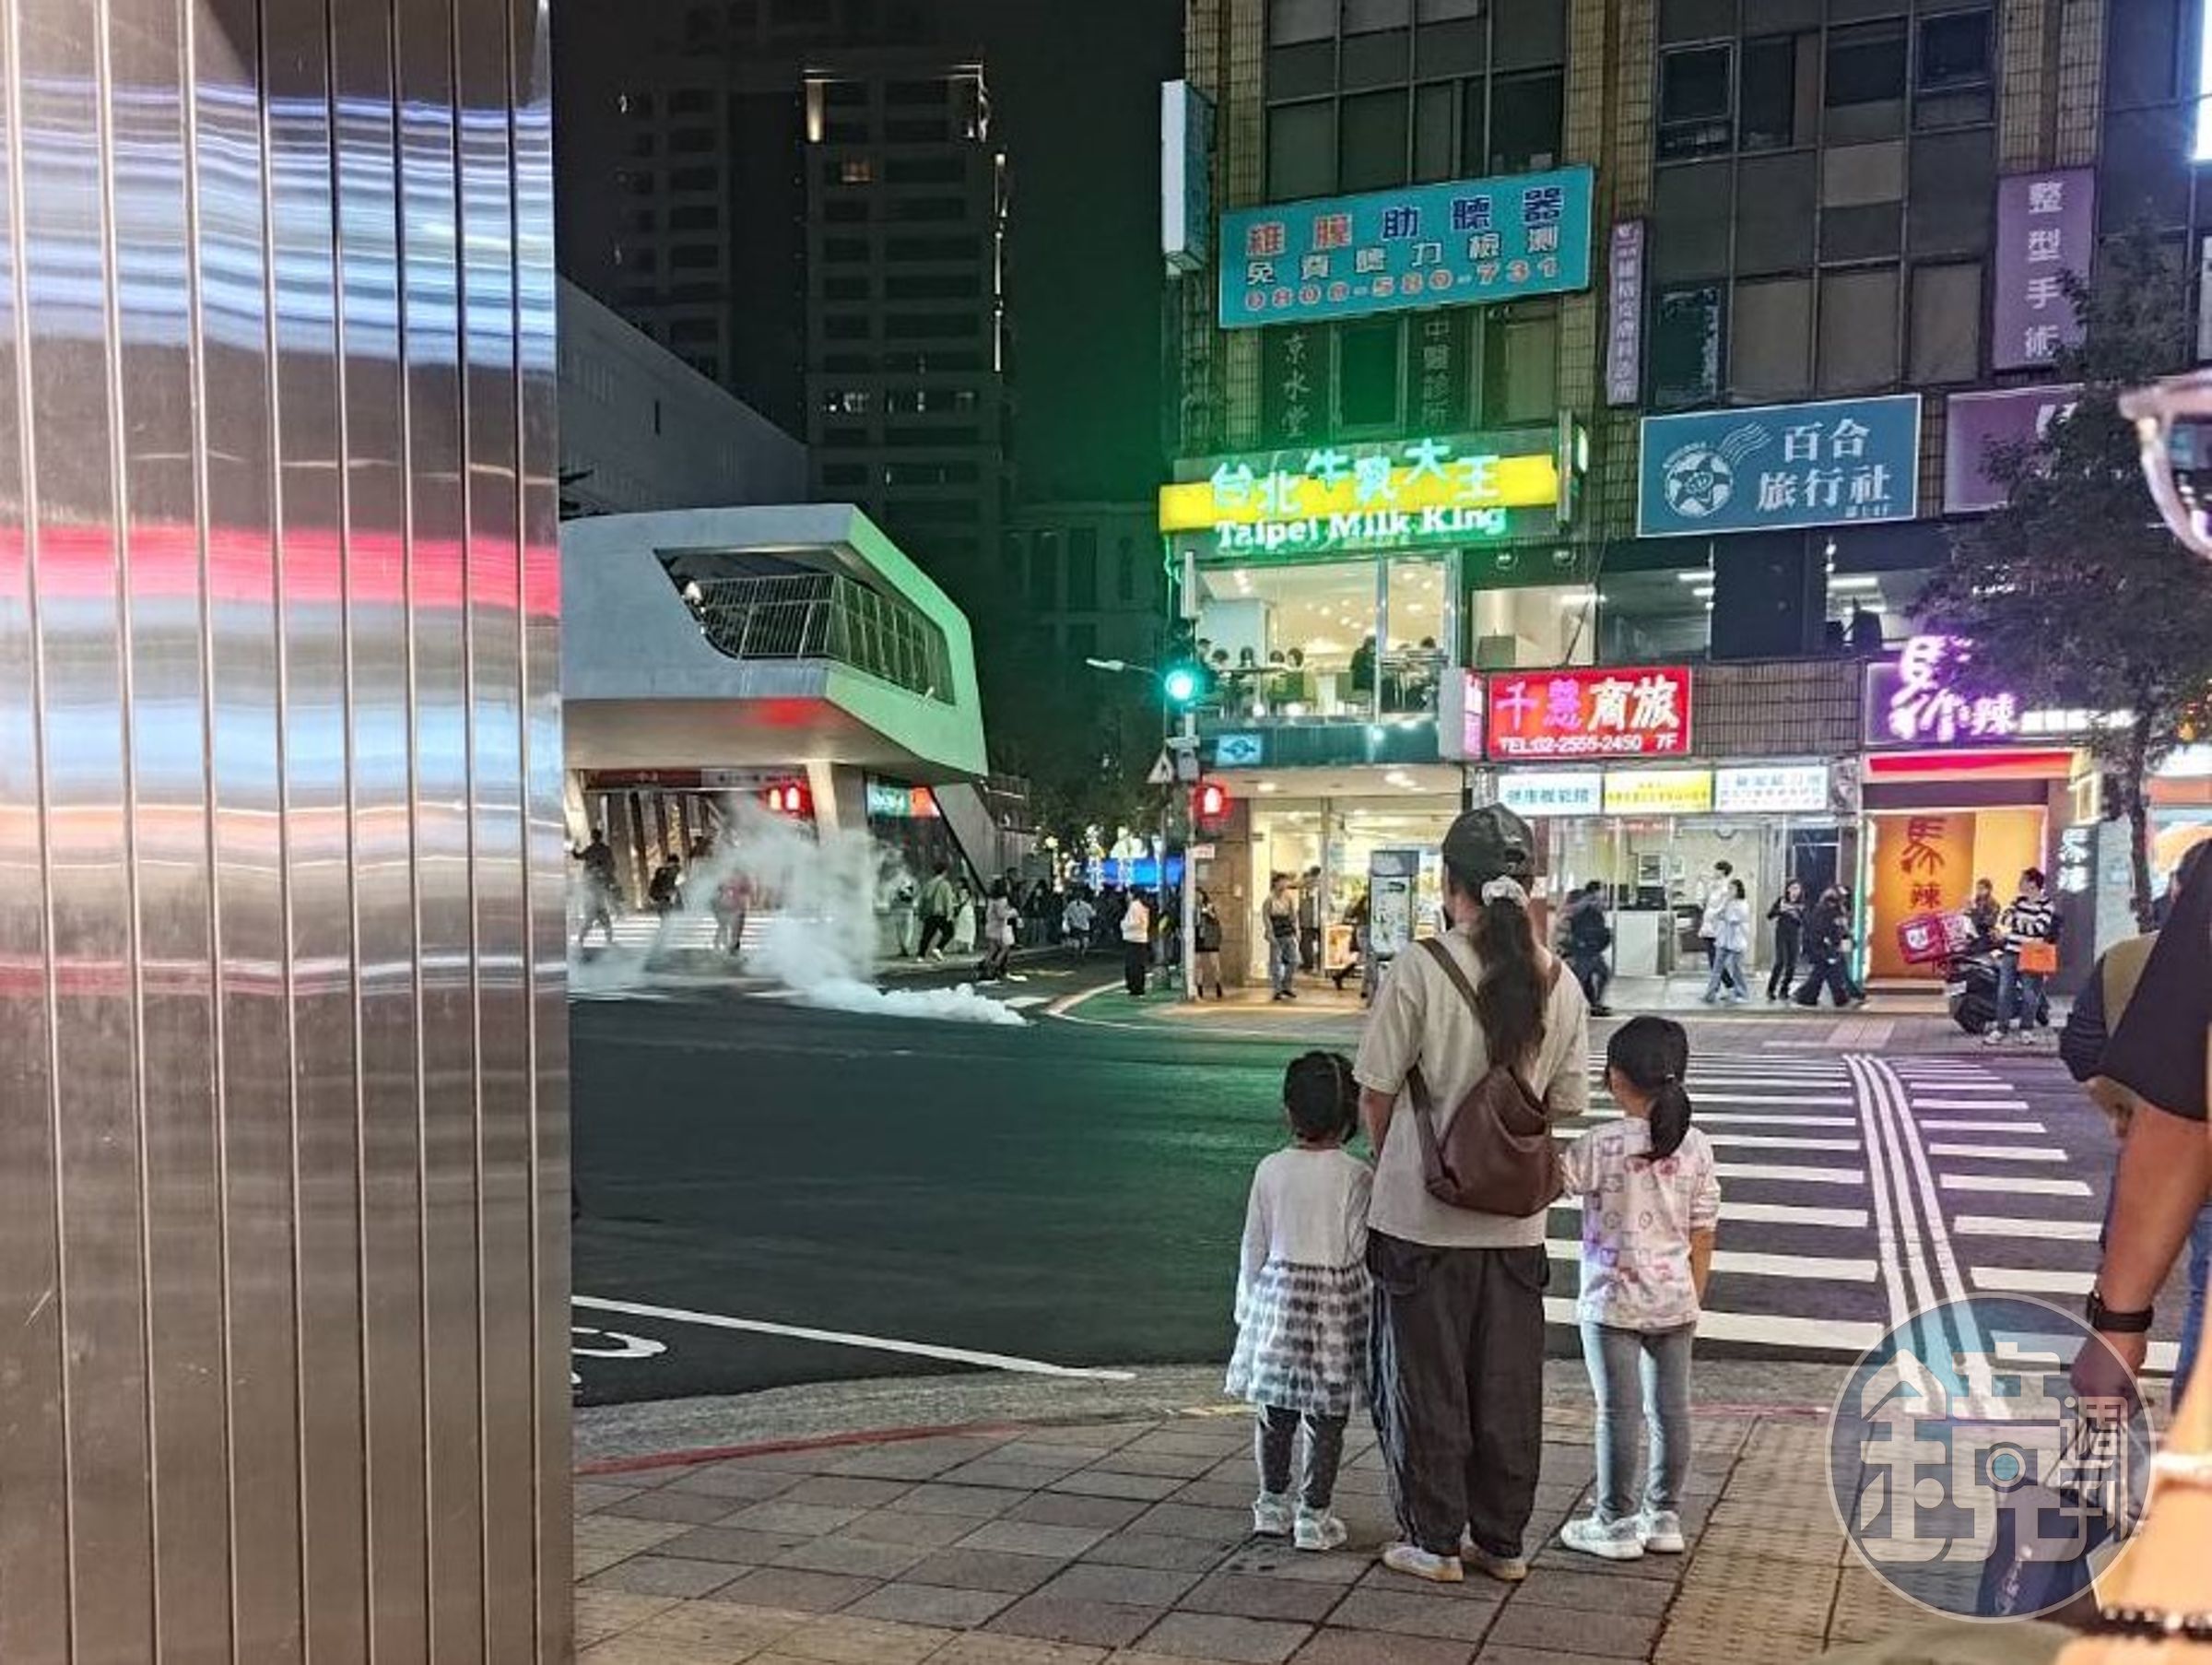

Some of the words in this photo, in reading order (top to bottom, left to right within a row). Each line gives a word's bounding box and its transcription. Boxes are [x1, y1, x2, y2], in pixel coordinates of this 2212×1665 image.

[1247, 226, 1559, 286] 免費聽力檢測
[2025, 182, 2064, 360] 整型手術
[1422, 316, 1452, 428] 中醫診所
[1783, 418, 1871, 463] 百合
[1211, 438, 1500, 514] 台北牛乳大王
[1756, 465, 1891, 513] 旅行社
[1215, 514, 1319, 550] Taipei
[1328, 509, 1413, 540] Milk
[1419, 505, 1507, 535] King
[1655, 732, 1678, 751] 7F
